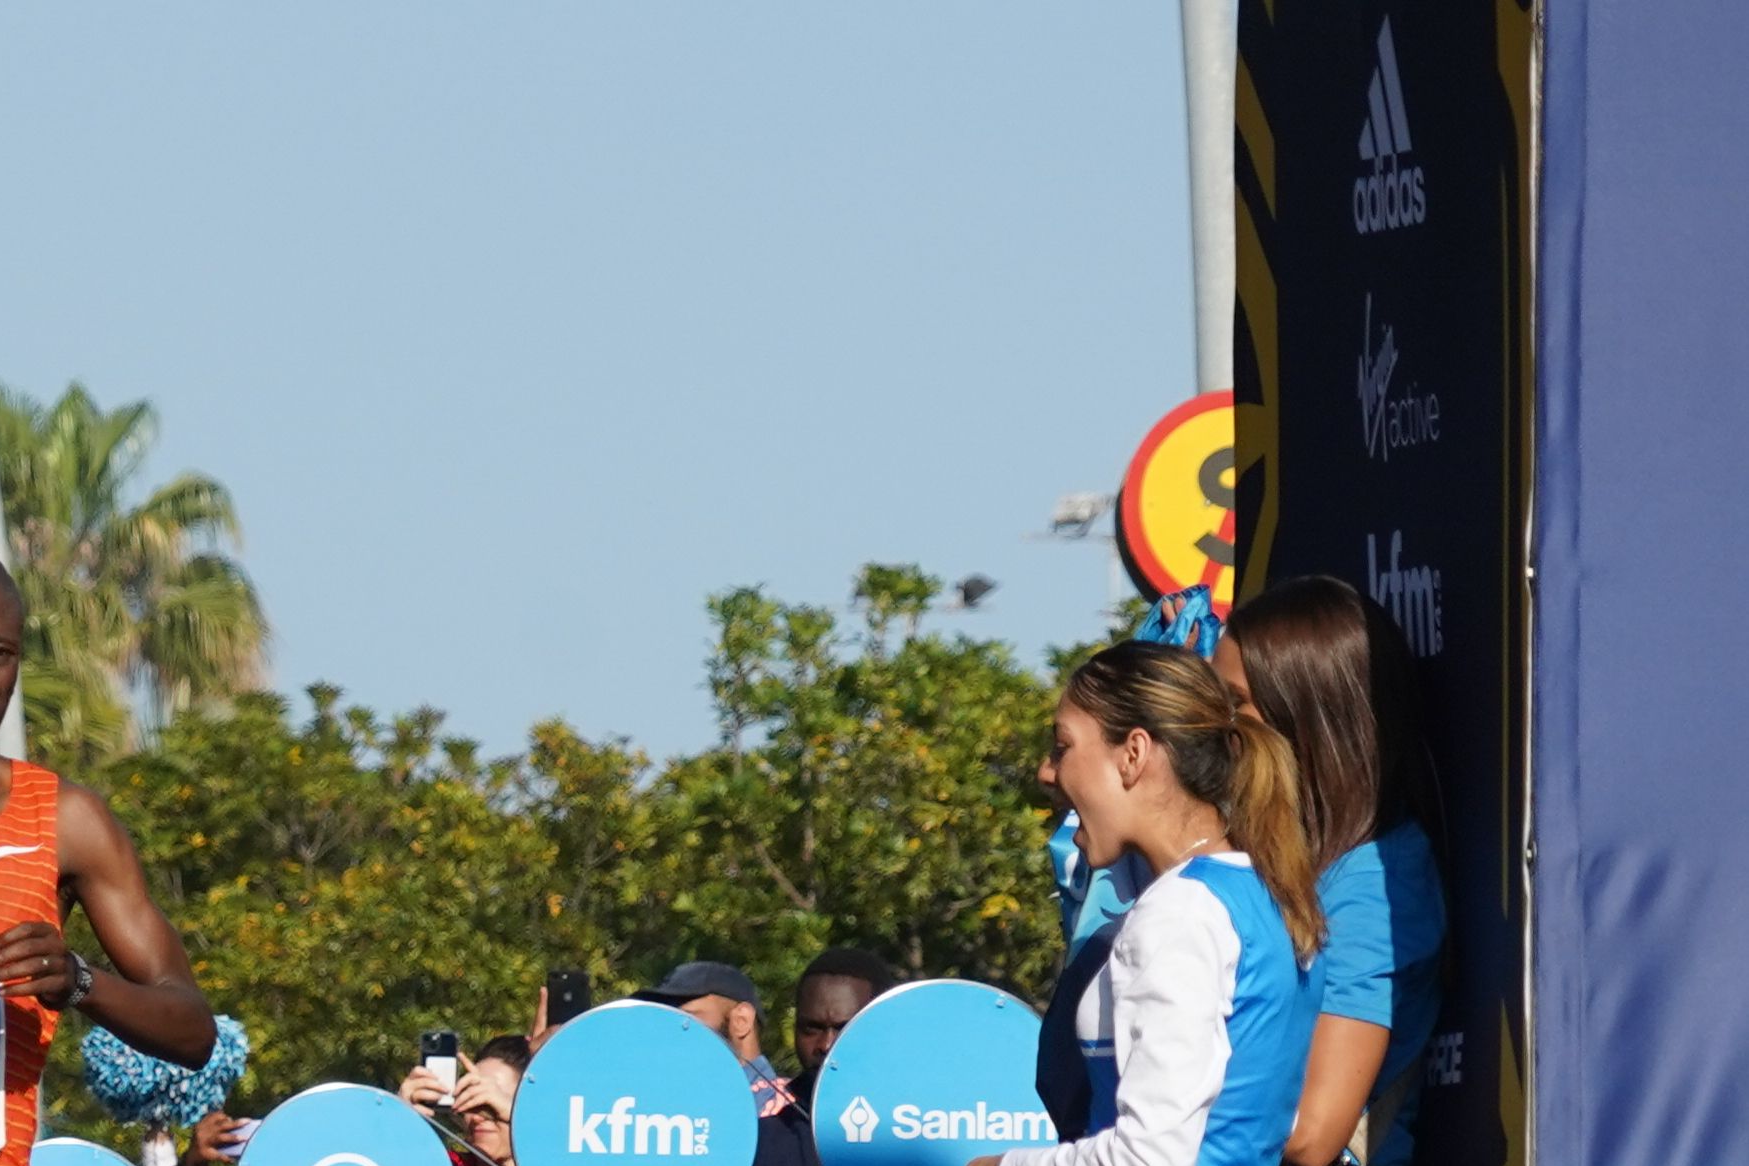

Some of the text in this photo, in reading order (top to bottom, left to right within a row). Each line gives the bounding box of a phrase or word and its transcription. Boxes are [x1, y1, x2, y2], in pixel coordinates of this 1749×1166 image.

[1354, 153, 1426, 235] adidas
[1387, 382, 1440, 448] active
[568, 1095, 694, 1156] kfm
[694, 1117, 710, 1156] 94.5
[891, 1101, 1059, 1141] Sanlam
